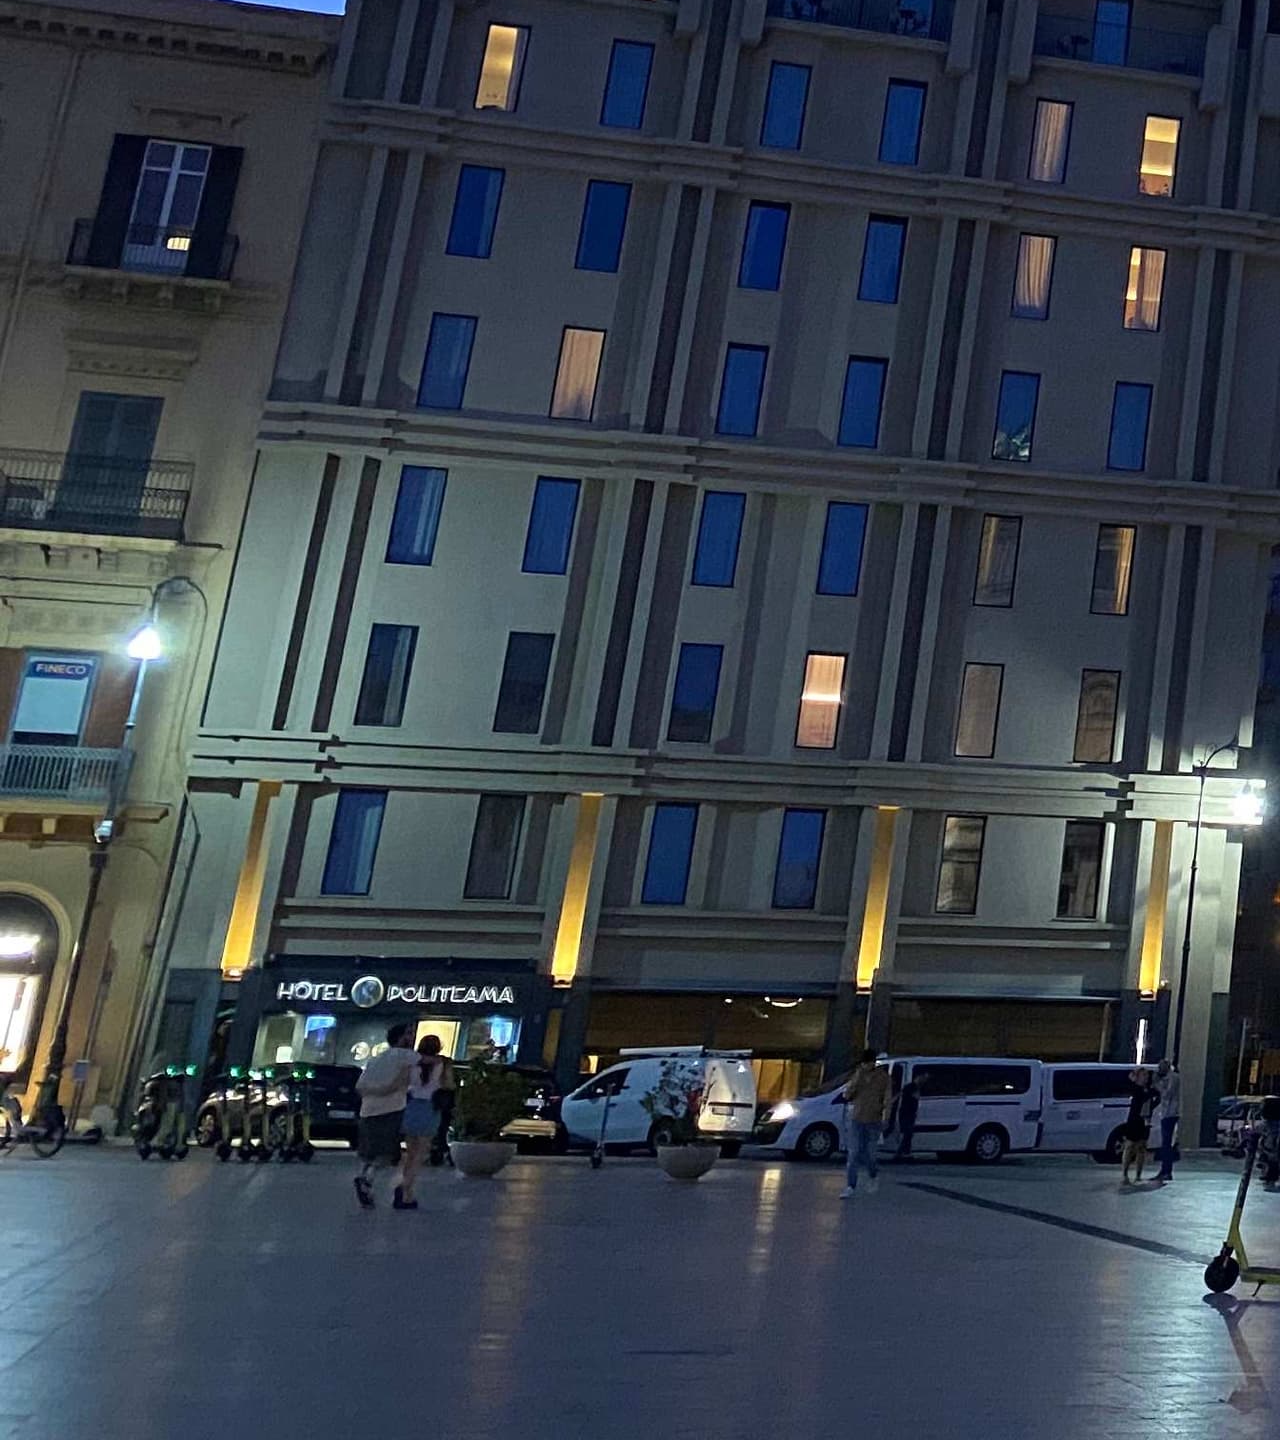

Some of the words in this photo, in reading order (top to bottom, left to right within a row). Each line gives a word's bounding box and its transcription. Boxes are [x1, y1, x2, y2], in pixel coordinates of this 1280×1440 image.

[35, 663, 87, 675] FINECO
[276, 981, 348, 1001] HOTEL
[386, 984, 515, 1003] POLITEAMA
